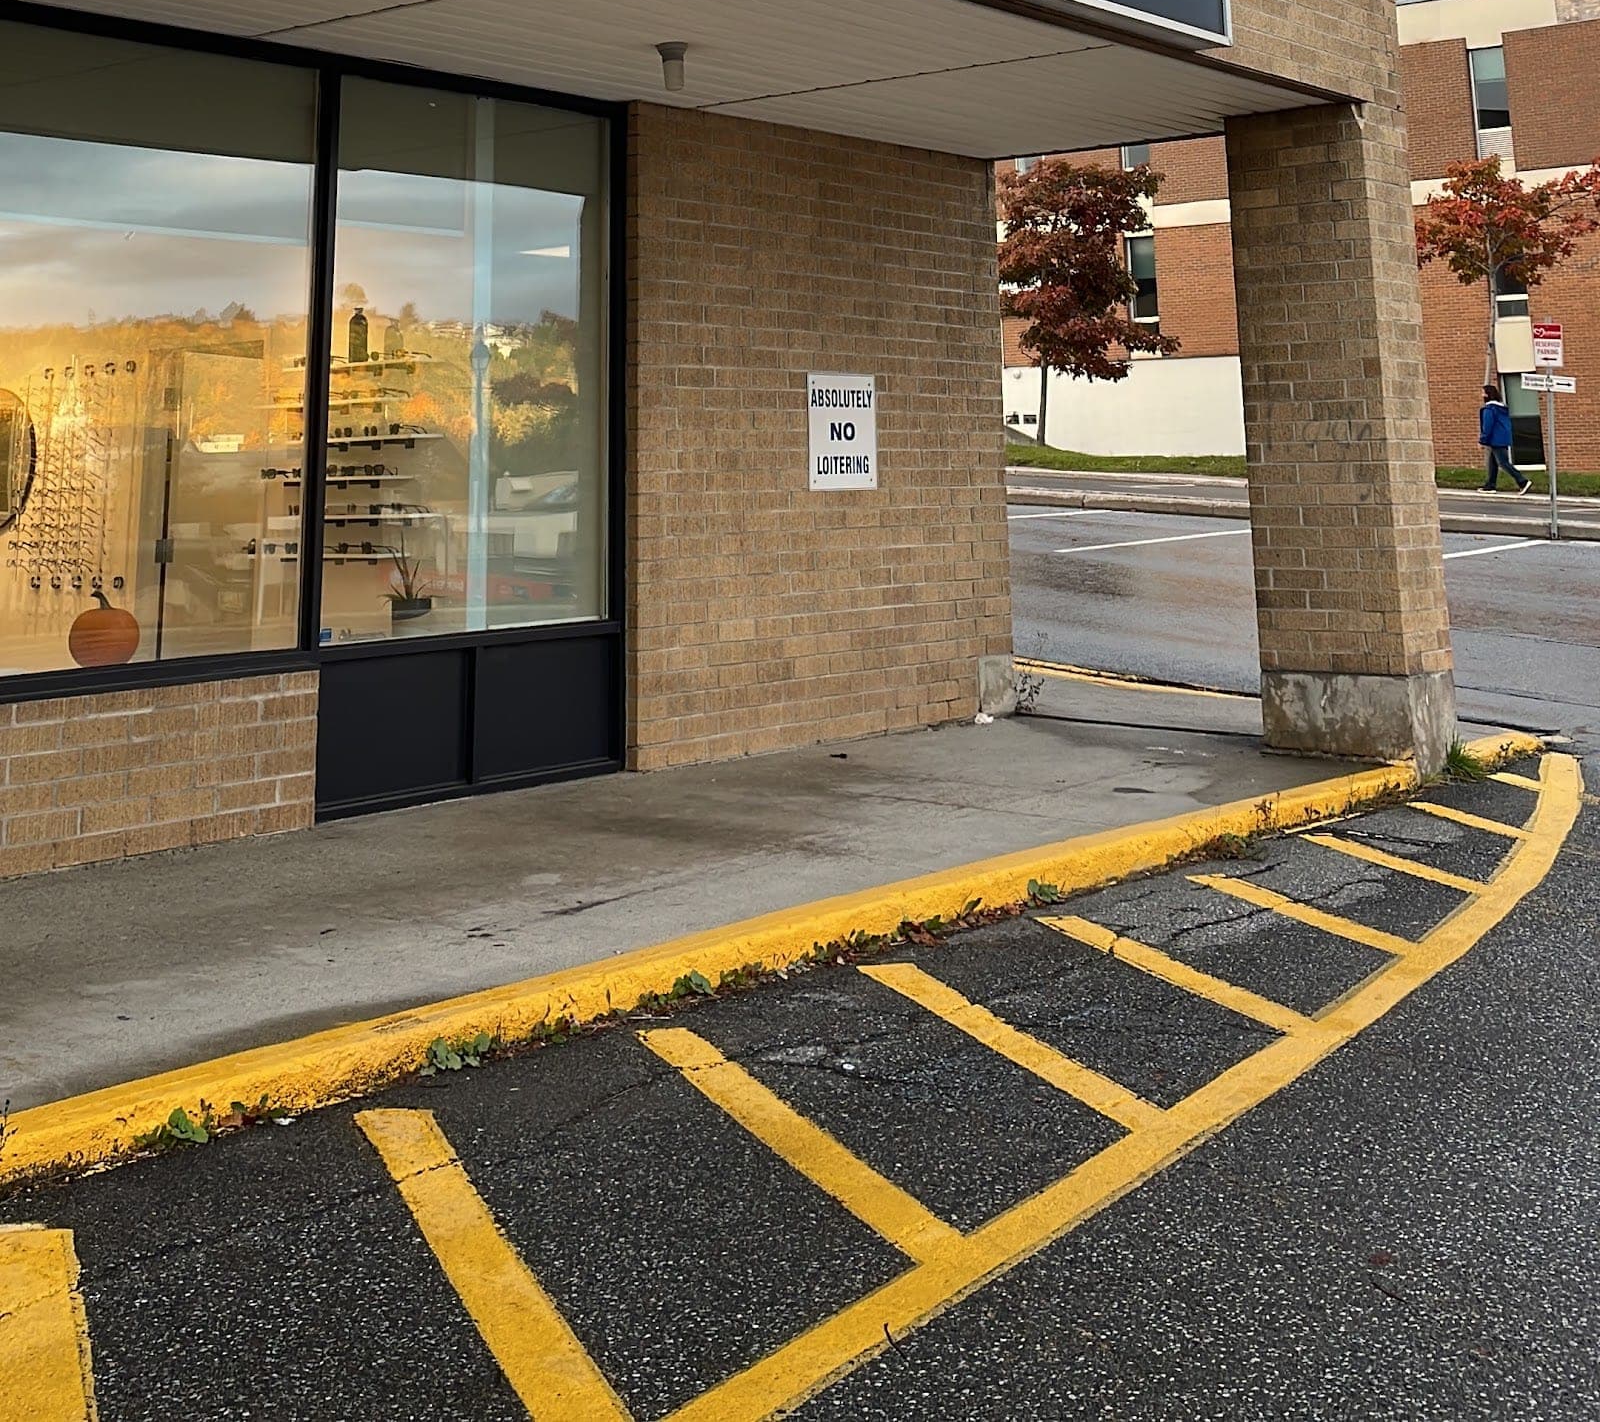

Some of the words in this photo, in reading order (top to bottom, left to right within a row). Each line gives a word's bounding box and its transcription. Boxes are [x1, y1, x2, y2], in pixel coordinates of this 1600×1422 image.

[810, 389, 873, 409] ABSOLUTELY
[829, 422, 856, 441] NO
[817, 455, 870, 475] LOITERING
